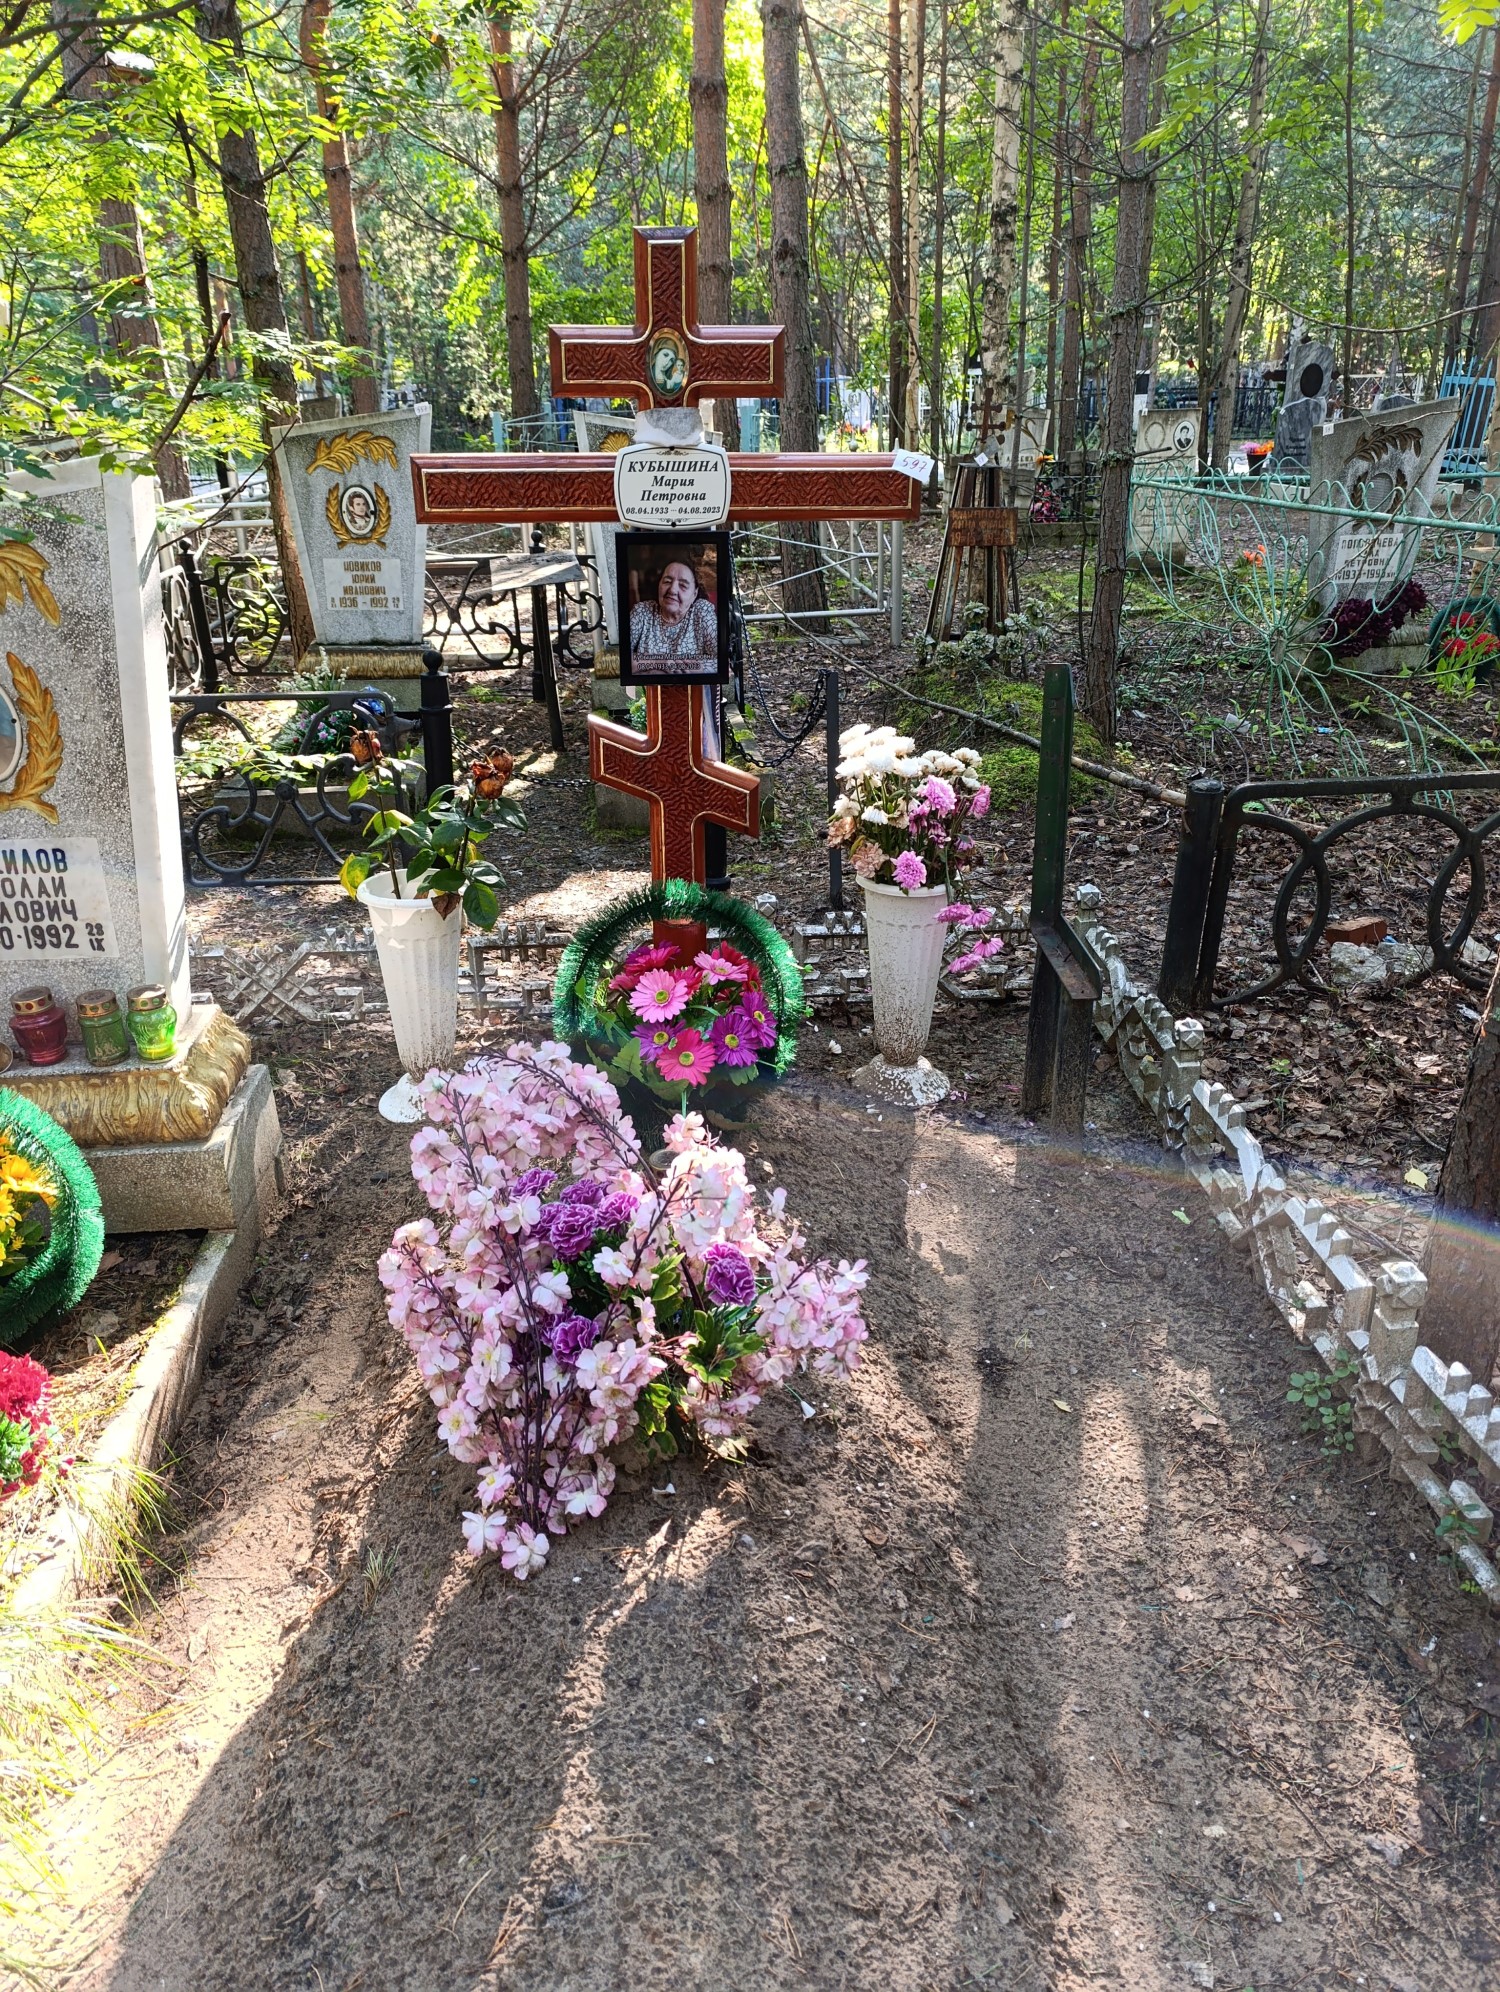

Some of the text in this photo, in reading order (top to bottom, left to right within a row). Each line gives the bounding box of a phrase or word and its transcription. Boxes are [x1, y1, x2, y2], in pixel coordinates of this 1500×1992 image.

[627, 460, 718, 472] КУБЫШИНА
[902, 456, 927, 472] 597
[651, 476, 695, 489] Мария
[640, 490, 706, 503] Петровна
[678, 506, 721, 514] 04.08.2023
[343, 561, 382, 572] НОВИКОВ
[351, 573, 376, 584] ЮРИЙ
[343, 585, 386, 595] ИВАНОВИЧ
[339, 597, 358, 608] 1936
[370, 597, 389, 608] 1992
[0, 848, 68, 874] ИЛОВ
[85, 923, 105, 936] 28
